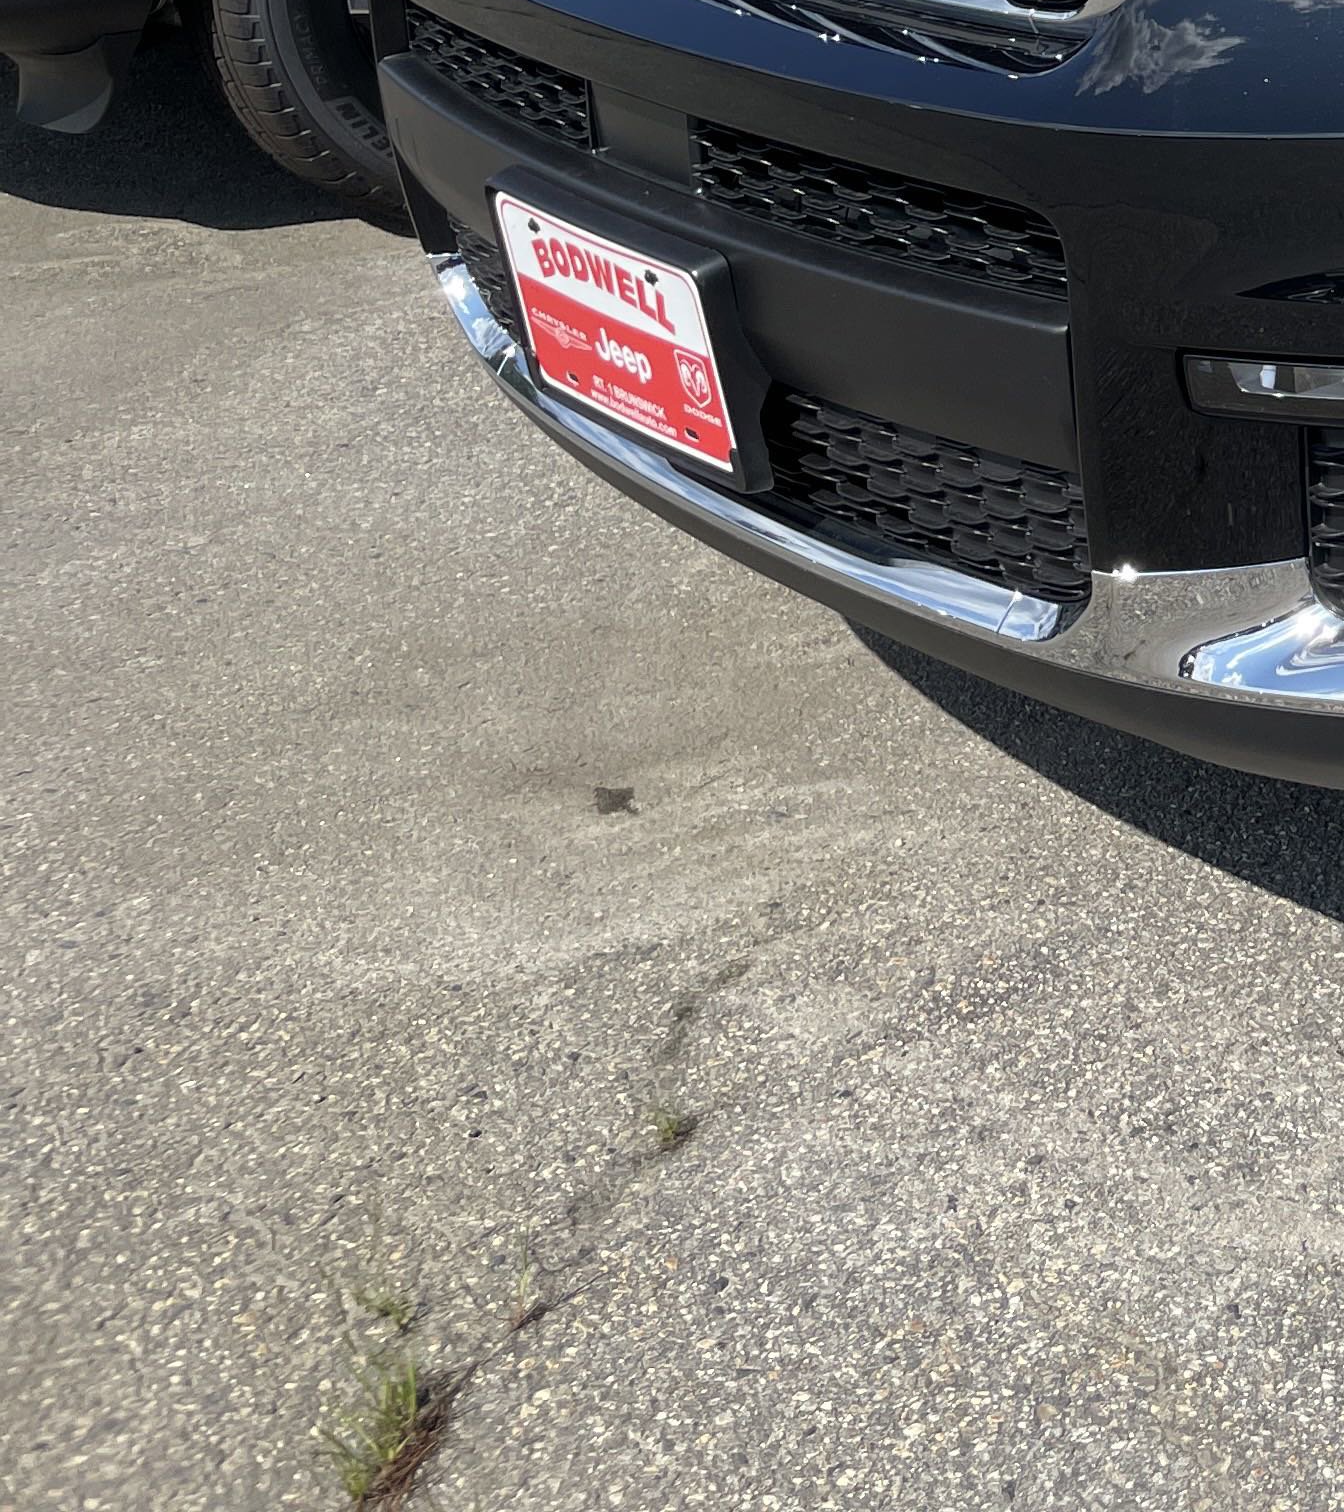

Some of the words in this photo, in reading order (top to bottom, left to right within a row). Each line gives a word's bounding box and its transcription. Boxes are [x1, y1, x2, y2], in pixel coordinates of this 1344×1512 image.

[531, 237, 677, 337] BODWELL
[530, 306, 588, 341] CHRYSLER
[594, 328, 653, 384] Jeep
[612, 384, 668, 422] BRUNSWICK
[683, 403, 723, 427] DODGE
